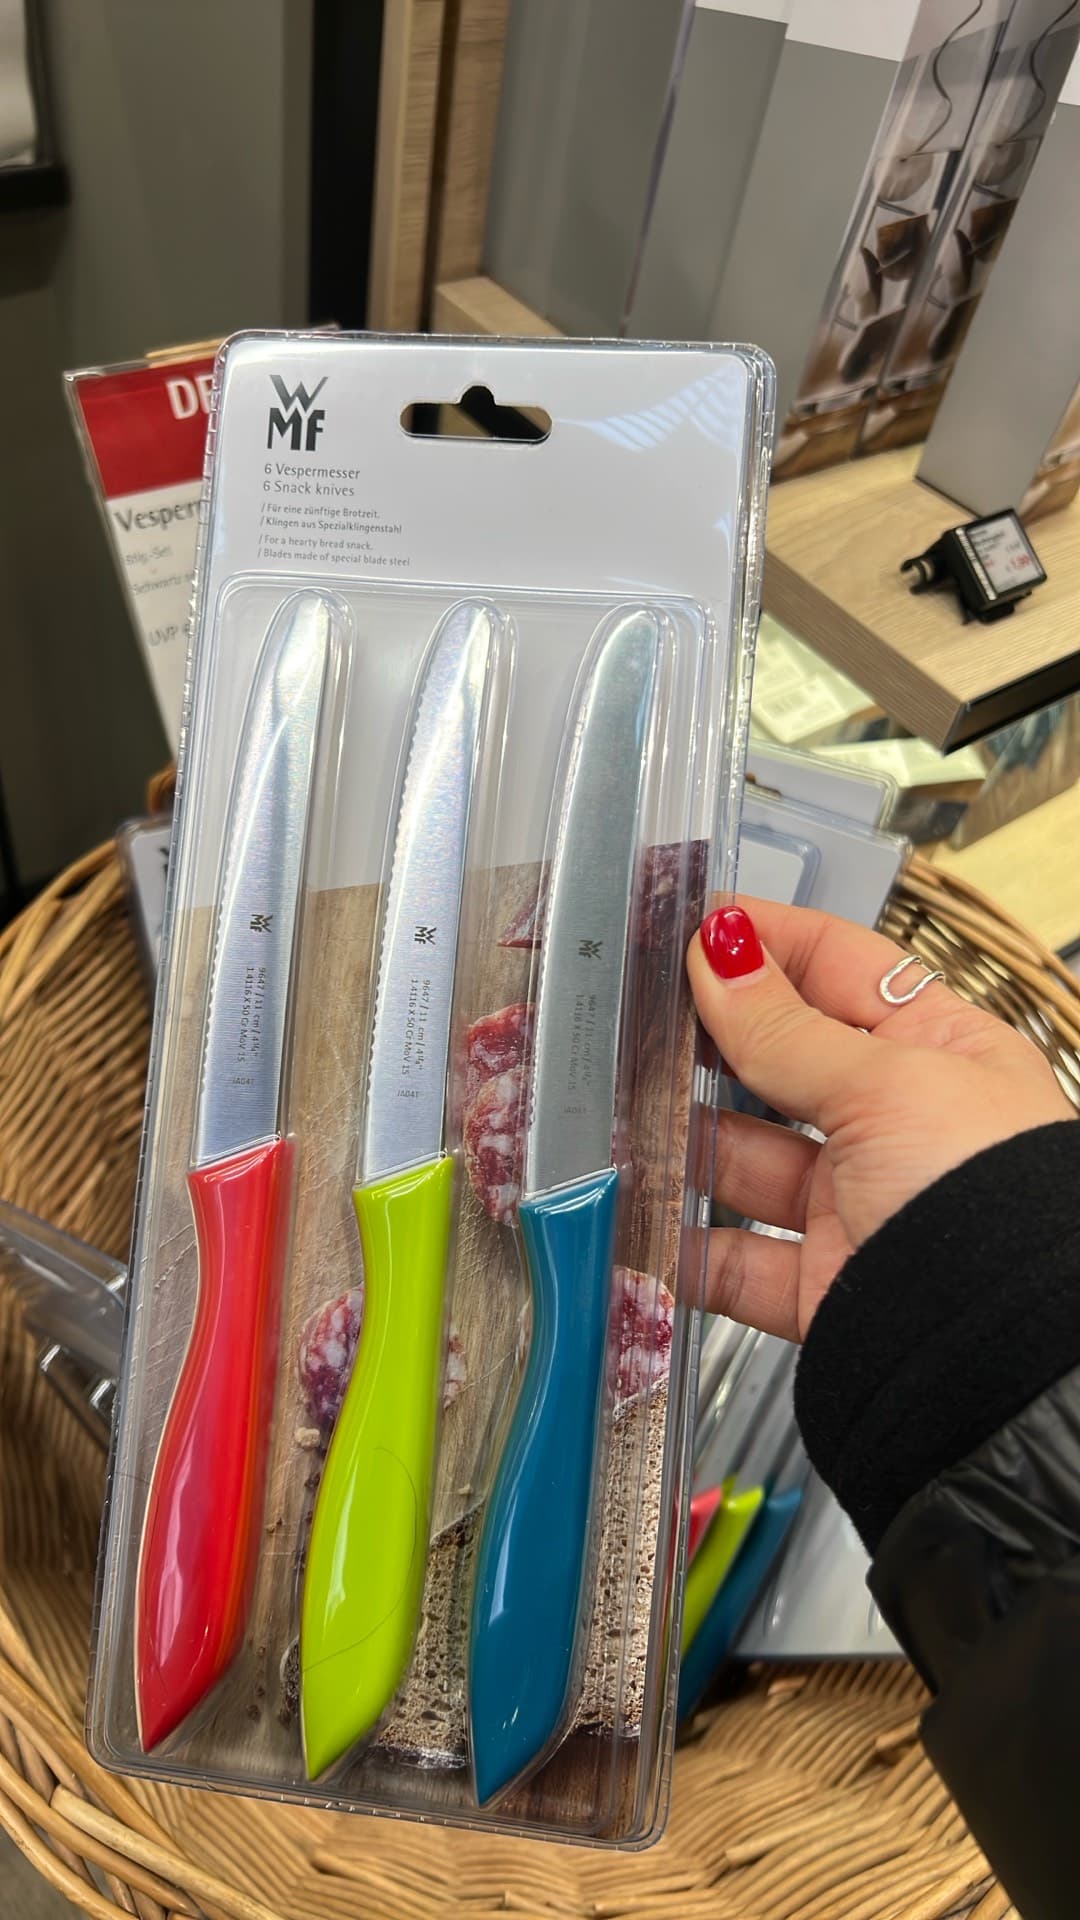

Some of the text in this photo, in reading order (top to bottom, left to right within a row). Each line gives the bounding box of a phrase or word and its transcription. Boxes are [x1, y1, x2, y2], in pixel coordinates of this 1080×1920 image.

[264, 462, 360, 480] 6 Vespermesser
[263, 480, 355, 496] 6 Snack knives
[114, 501, 203, 532] Vesper
[267, 503, 281, 513] Für
[283, 505, 302, 514] eine
[304, 505, 340, 518] zünftige
[343, 508, 380, 519] Brotzeit.
[266, 516, 299, 529] Klingen
[301, 521, 316, 529] aus
[318, 520, 402, 534] Spezialklingenstahl
[264, 534, 279, 545] For
[280, 537, 286, 545] a
[288, 535, 318, 548] hearty
[319, 538, 344, 549] bread
[346, 540, 374, 550] snack.
[263, 548, 292, 559] Blades
[294, 551, 318, 561] made
[319, 552, 329, 561] of
[331, 553, 361, 564] special
[363, 555, 387, 565] blade
[389, 556, 411, 566] steel
[256, 967, 266, 990] 9647
[422, 979, 431, 1003] 9647
[242, 1005, 250, 1016] 50
[406, 1017, 415, 1028] 50
